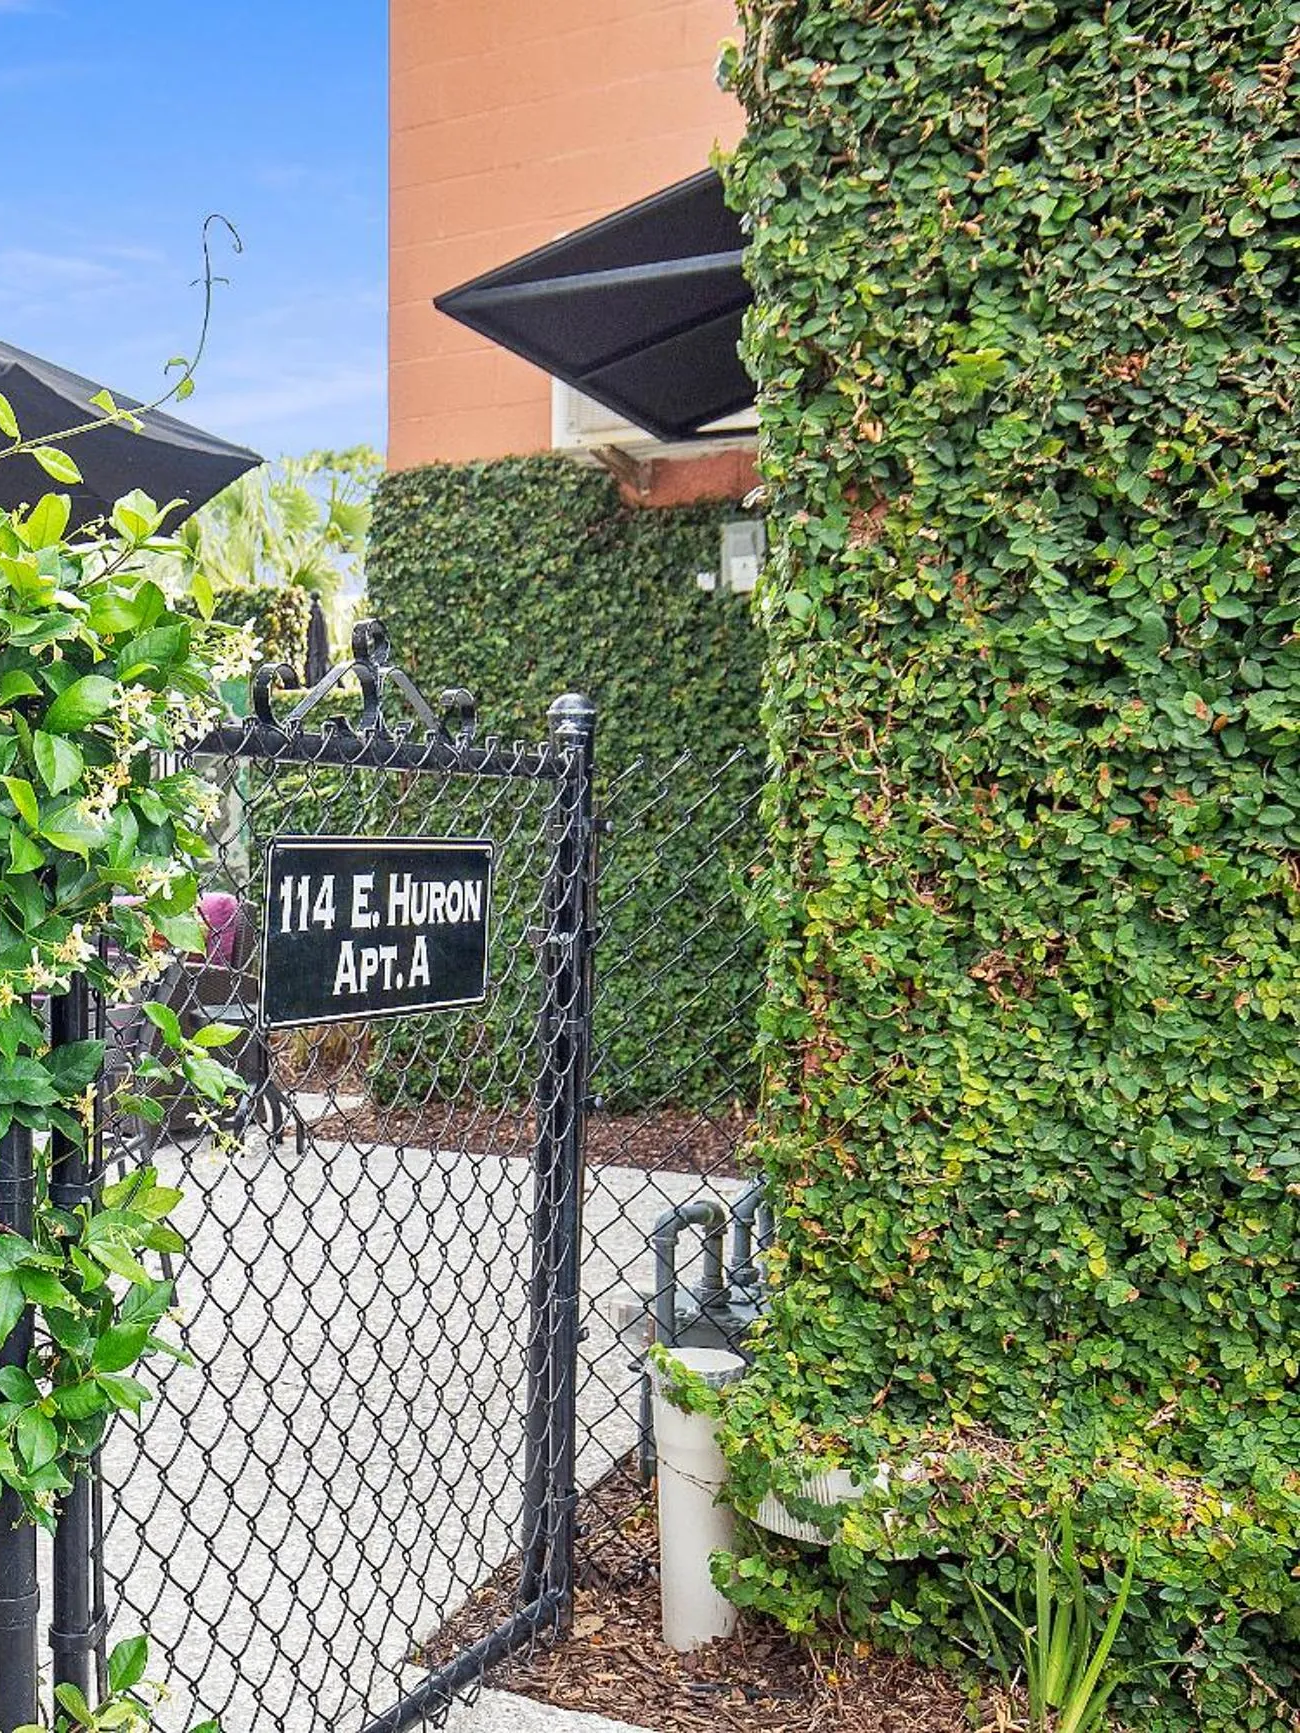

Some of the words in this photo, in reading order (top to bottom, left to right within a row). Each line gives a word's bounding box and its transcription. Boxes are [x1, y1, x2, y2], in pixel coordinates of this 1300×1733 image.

[279, 874, 337, 933] 114
[350, 871, 380, 930] E.
[386, 873, 483, 927] HURON
